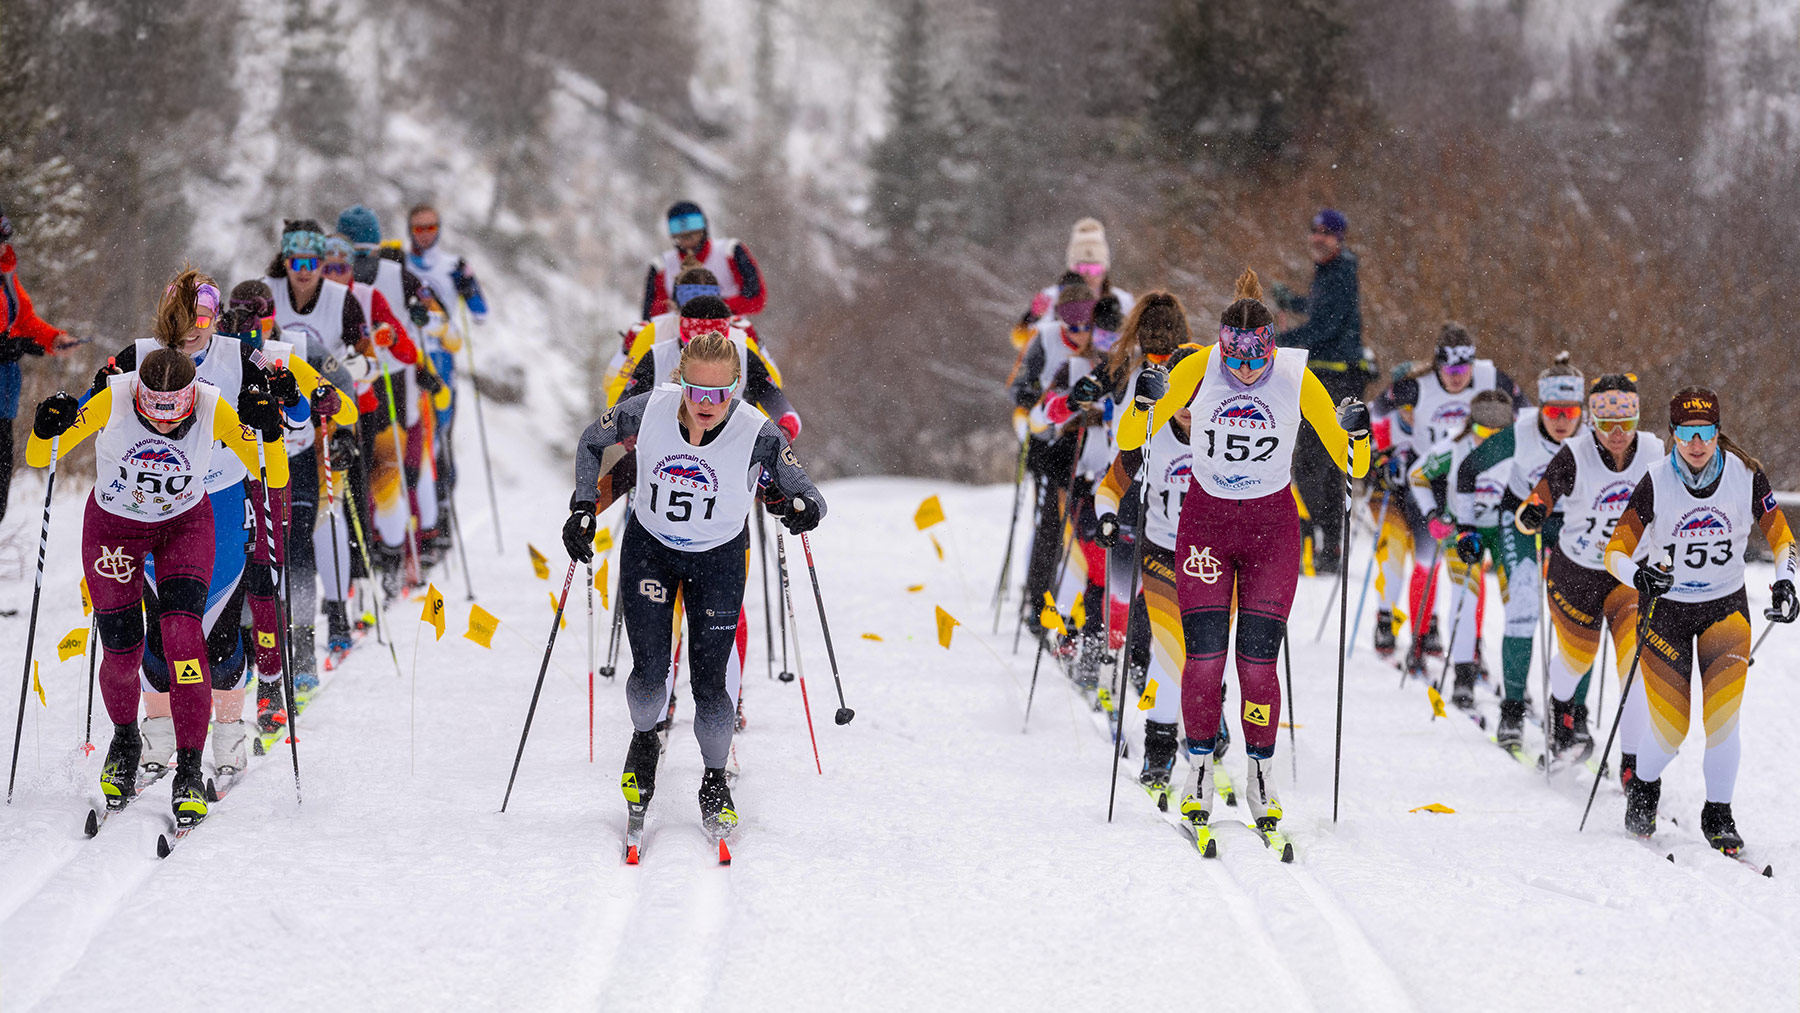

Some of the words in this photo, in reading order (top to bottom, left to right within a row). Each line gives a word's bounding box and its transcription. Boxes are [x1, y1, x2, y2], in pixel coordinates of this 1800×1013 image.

[1210, 405, 1223, 423] Rocky
[1221, 394, 1253, 407] Mountain
[1253, 396, 1276, 429] Conference
[1218, 418, 1267, 430] USCSA
[121, 445, 137, 462] Rocky
[135, 438, 167, 449] Mountain
[1204, 429, 1279, 462] 152
[130, 458, 182, 472] USCSA
[1170, 453, 1193, 466] Mountai
[652, 459, 665, 476] Rocky
[664, 453, 699, 463] Mountain
[699, 459, 719, 492] Conference
[659, 471, 710, 491] USCSA
[1232, 479, 1262, 489] COUNTY
[109, 479, 126, 492] AF
[649, 482, 717, 522] 151
[1586, 517, 1620, 538] 15
[1671, 520, 1684, 537] Rocky
[1681, 505, 1710, 521] Mountain
[1680, 529, 1724, 538] USCSA
[1663, 538, 1733, 569] 153
[640, 579, 668, 603] CU
[1553, 591, 1594, 624] WYOMING
[1640, 626, 1680, 662] YOMING
